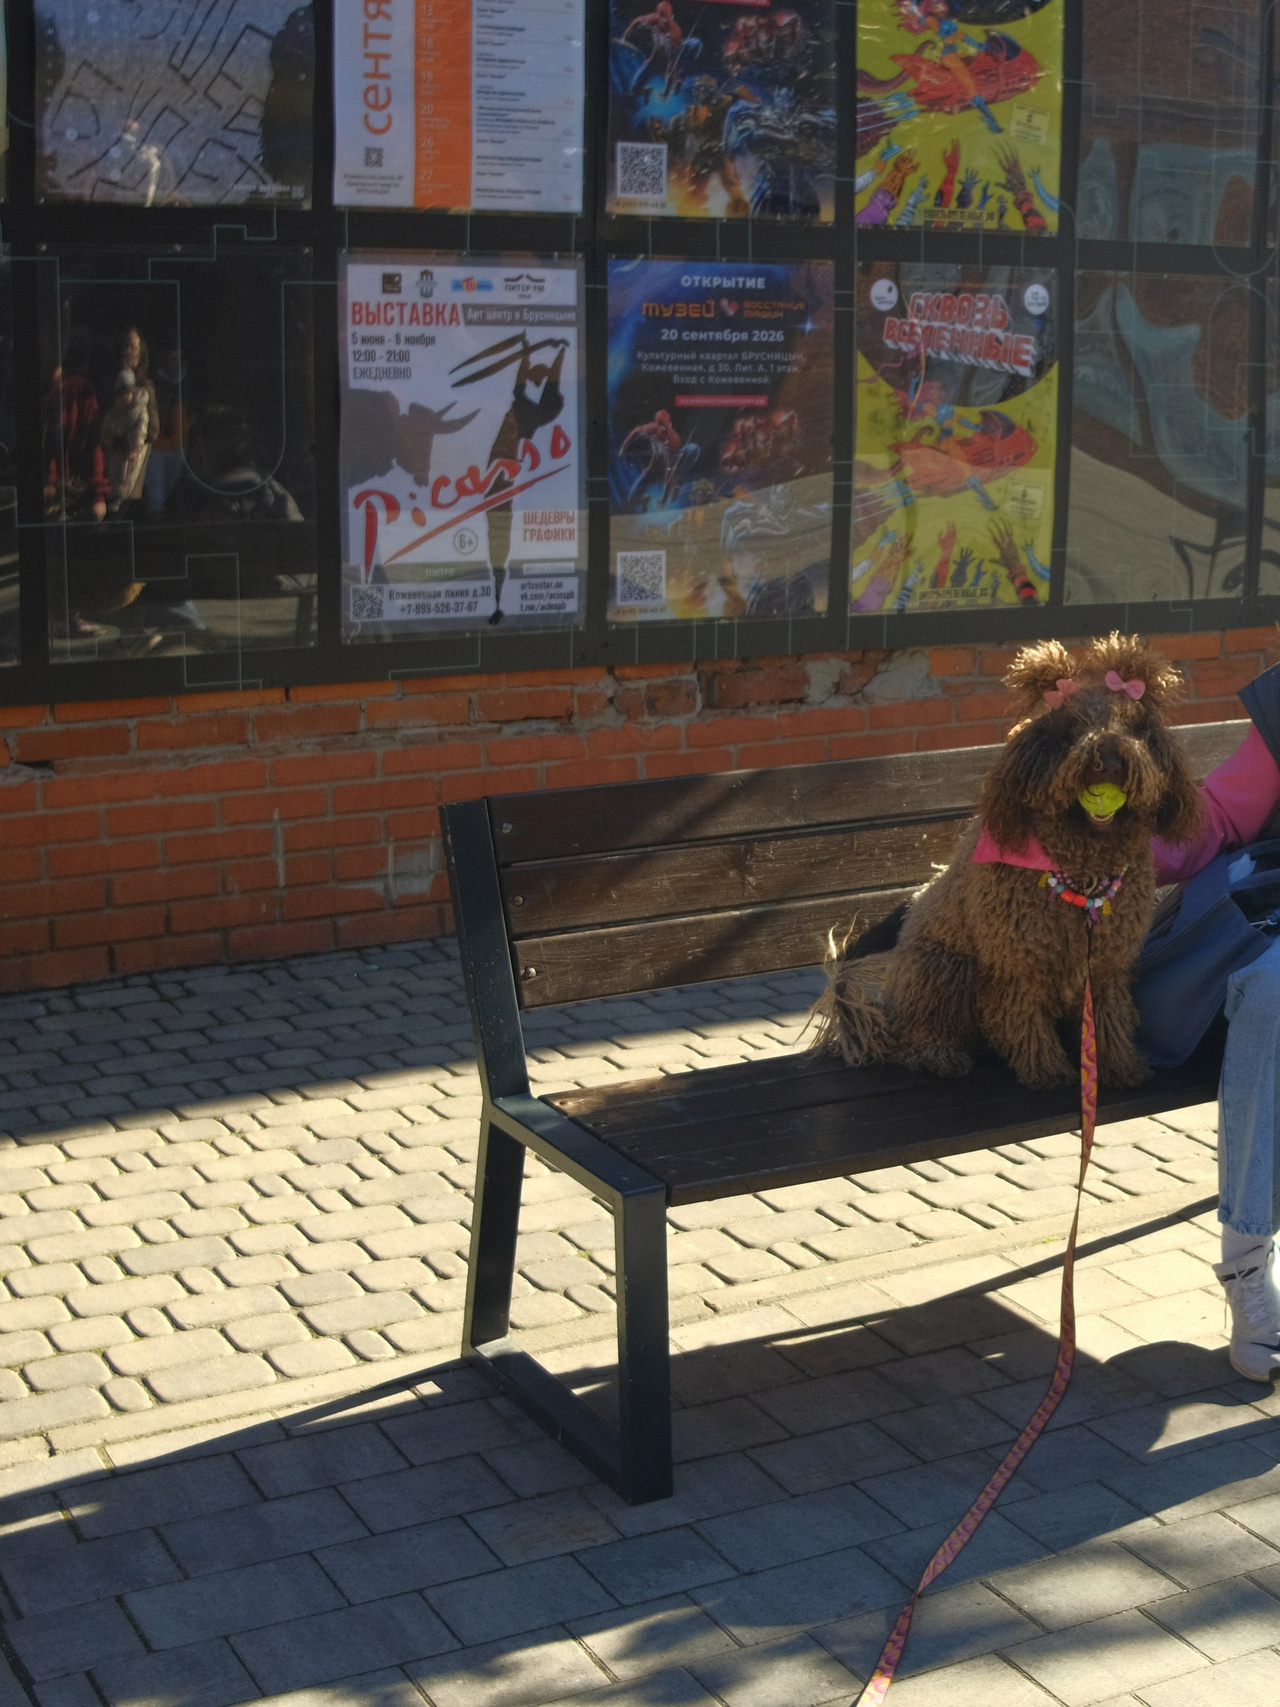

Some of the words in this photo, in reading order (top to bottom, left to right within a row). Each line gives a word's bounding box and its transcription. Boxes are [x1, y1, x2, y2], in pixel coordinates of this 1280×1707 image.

[421, 71, 434, 82] 19
[421, 104, 434, 115] 20
[421, 137, 434, 148] 26
[421, 170, 433, 180] 27
[505, 284, 531, 292] ПИТЕР
[681, 275, 766, 289] ОТКРЫТИЕ
[351, 301, 461, 326] ВЫСТАВКА
[467, 308, 483, 321] Арт
[486, 309, 513, 322] центр
[515, 310, 520, 320] в
[523, 309, 576, 322] Брусницыне
[907, 291, 1010, 331] СКВОЗЬ
[352, 332, 358, 345] 5
[361, 335, 385, 345] июня
[395, 332, 402, 345] 8
[404, 333, 436, 348] ноября
[661, 329, 678, 341] 20
[682, 328, 749, 344] сентября
[752, 330, 785, 342] 2026
[883, 317, 1036, 372] ВСЕЛЕННЫЕ
[352, 350, 377, 362] 12:00
[386, 350, 410, 362] 21:00
[637, 350, 697, 362] Культурный
[699, 352, 739, 363] квартал
[353, 366, 412, 380] ЕЖЕДНЕВНО
[673, 375, 698, 385] Вход
[524, 510, 575, 526] ШЕДЕВРЫ
[459, 533, 475, 549] 6+
[524, 528, 575, 542] ГРАФИКИ
[444, 588, 470, 599] линия
[472, 585, 491, 598] д.30
